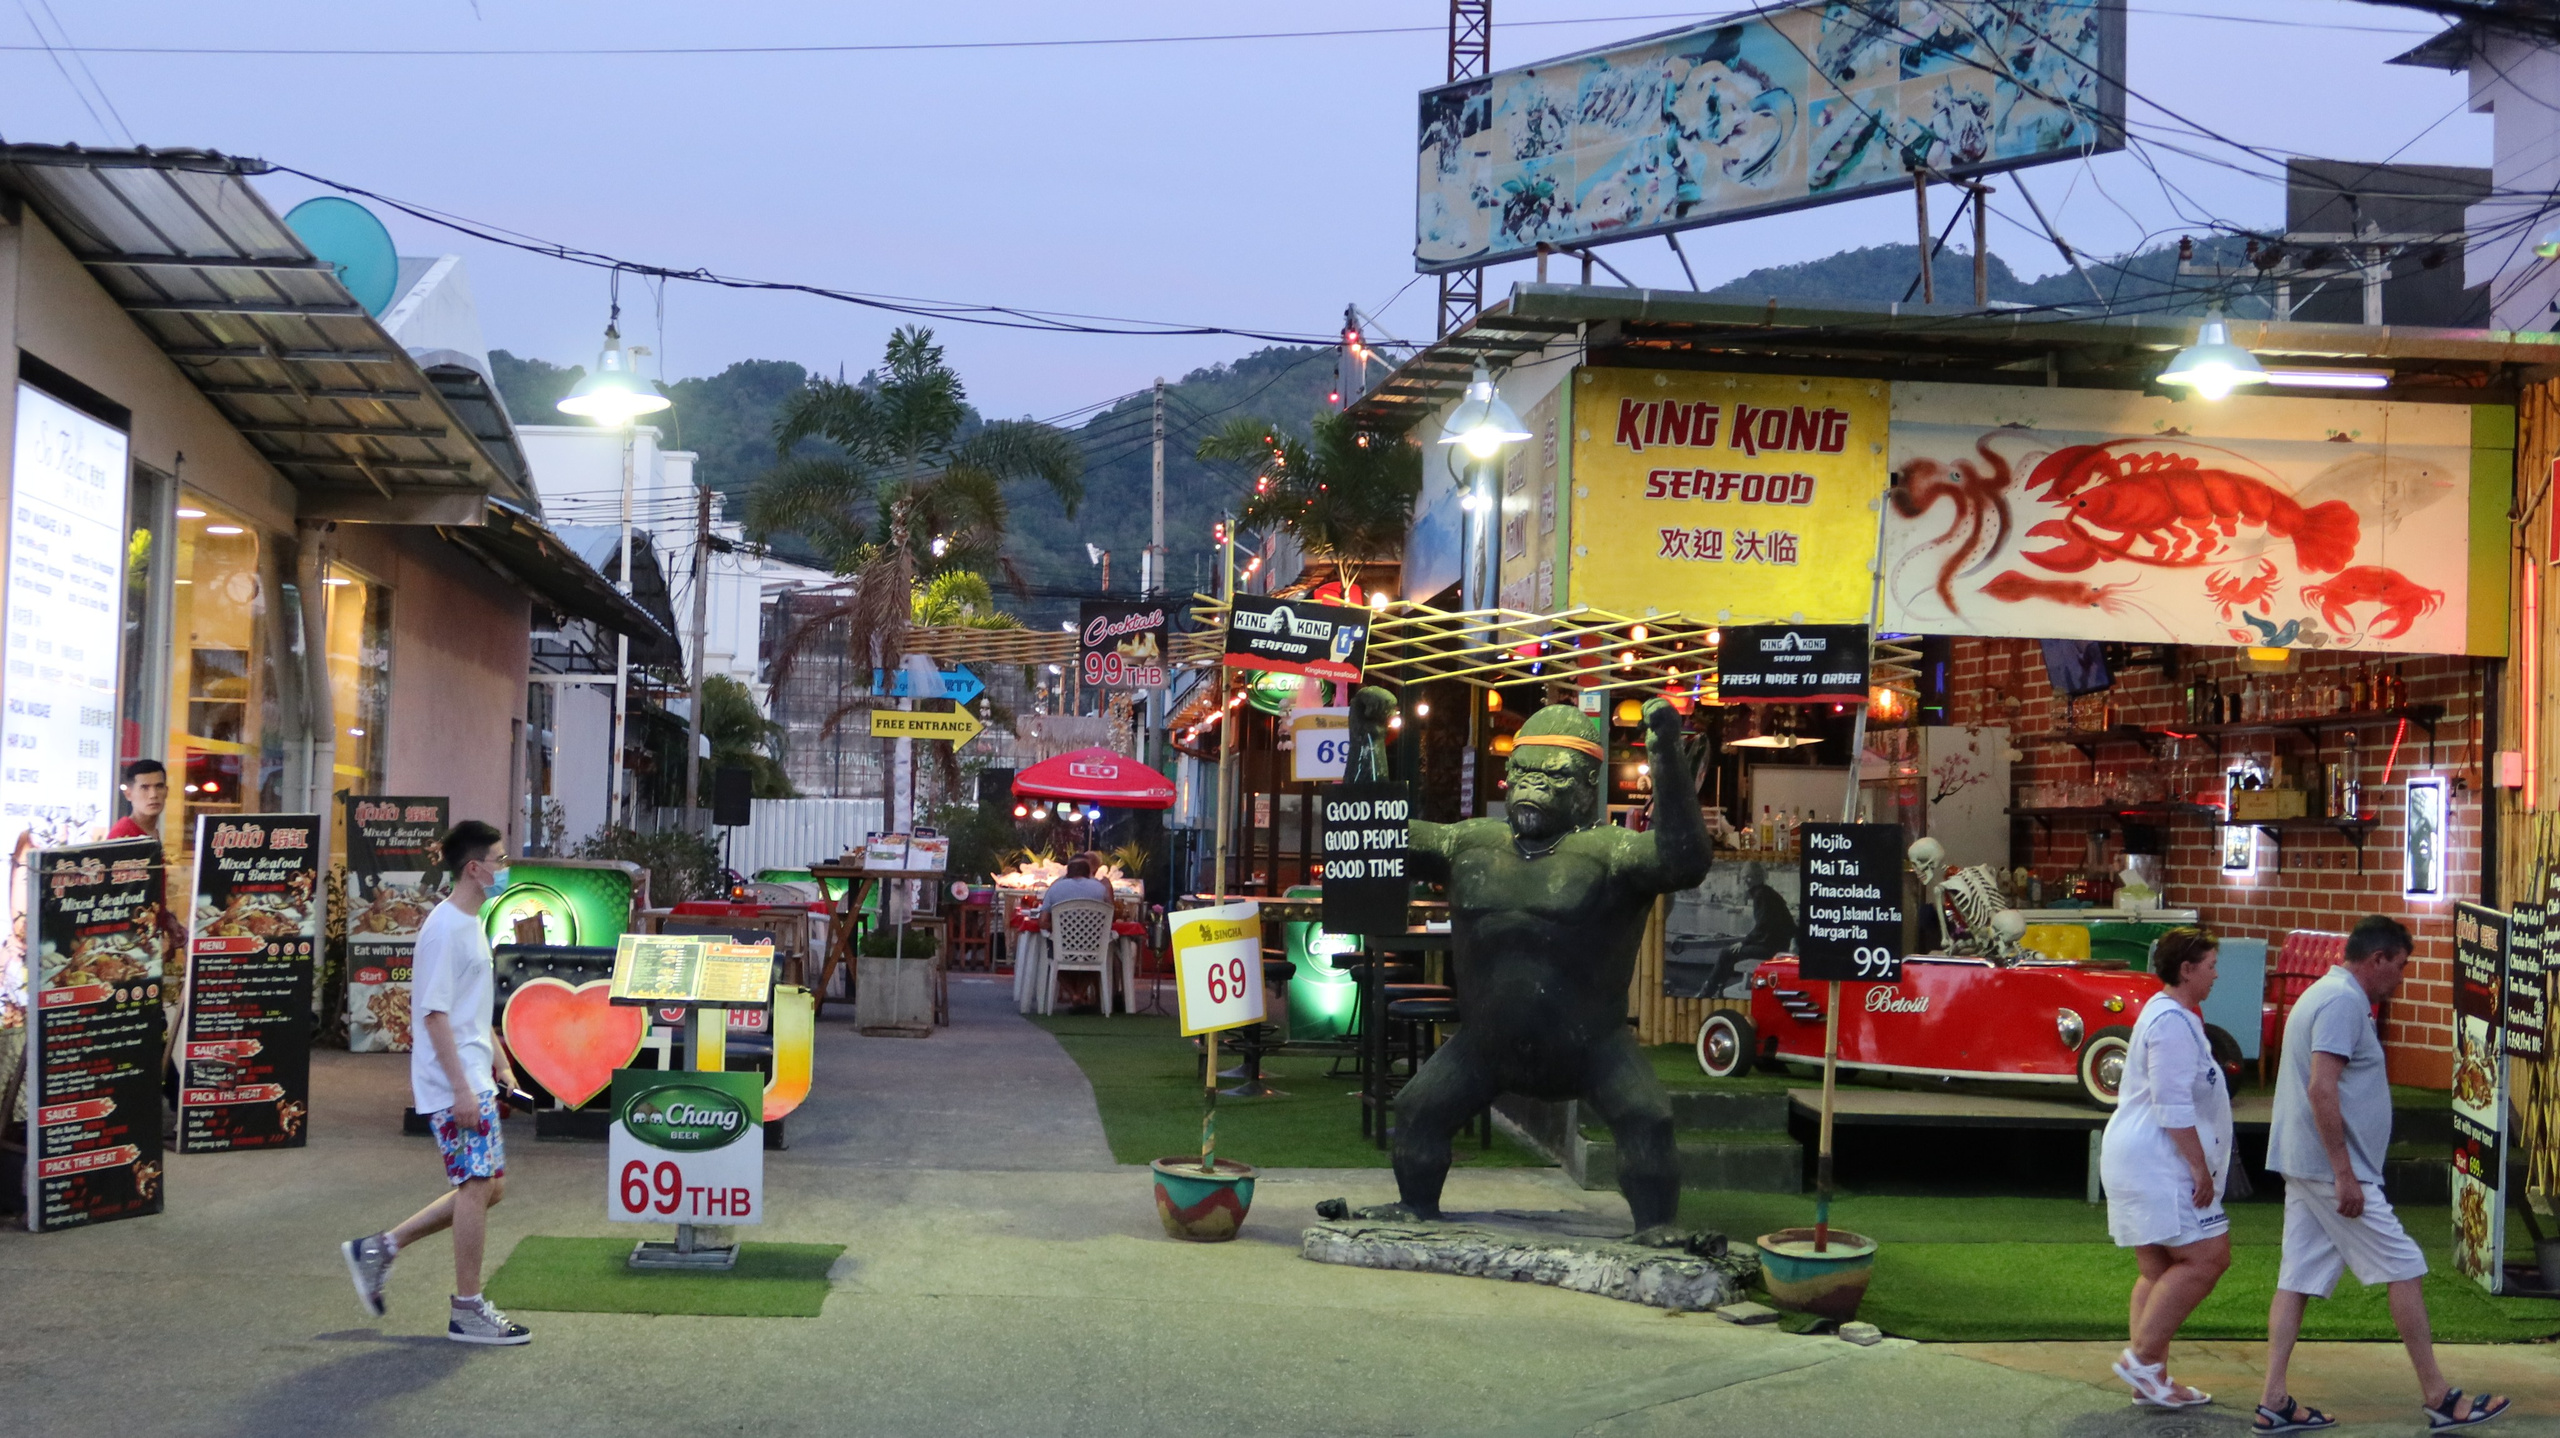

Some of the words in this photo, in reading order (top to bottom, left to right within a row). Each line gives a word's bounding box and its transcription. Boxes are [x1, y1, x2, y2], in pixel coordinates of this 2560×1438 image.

[1615, 397, 1720, 453] KING
[1730, 403, 1849, 457] KONG
[1645, 467, 1816, 506] SEAFOOD
[1659, 527, 1724, 561] 欢迎
[1083, 608, 1165, 647] Cocktail
[1235, 613, 1268, 629] KING
[1296, 621, 1330, 637] KONG
[1250, 638, 1308, 654] SEAFOOD
[1761, 640, 1783, 649] KING
[1802, 640, 1825, 649] KONG
[1773, 654, 1813, 663] SEAFOOD
[1084, 651, 1123, 686] 99
[1124, 666, 1163, 687] THB
[1304, 666, 1334, 679] Kingkong
[1333, 670, 1358, 680] seafood
[1721, 673, 1762, 686] FRESH
[1764, 673, 1799, 685] MADE
[1802, 673, 1818, 685] TO
[1821, 673, 1862, 685] ORDER
[875, 718, 906, 730] FREE
[908, 720, 973, 732] ENTRANCE
[1317, 739, 1351, 764] 69
[1072, 764, 1117, 778] LEO
[1326, 801, 1371, 822] GOOD
[1374, 799, 1409, 820] FOOD
[363, 827, 392, 838] Mixed
[394, 827, 435, 838] Seafood
[1324, 830, 1360, 851] GOOD
[1362, 828, 1409, 850] PEOPLE
[388, 837, 422, 847] Bucket
[1810, 832, 1853, 853] Mojito
[218, 857, 252, 870] Mixed
[255, 856, 303, 870] Seafood
[1324, 859, 1365, 879] GOOD
[1368, 858, 1405, 878] TIME
[1810, 858, 1835, 876] Mai
[1837, 859, 1860, 876] Tai
[232, 870, 245, 882] in
[247, 868, 287, 882] Bucket
[1809, 881, 1881, 900] Pinacolada
[60, 894, 96, 912] Mixed
[98, 888, 146, 908] Seafood
[75, 911, 89, 924] in
[91, 907, 130, 922] Bucket
[1809, 904, 1841, 924] Long
[1842, 905, 1874, 922] Island
[1875, 906, 1889, 922] Ice
[1889, 907, 1902, 922] Tea
[1213, 928, 1243, 941] SINGHA
[1808, 924, 1869, 942] Margarita
[198, 940, 227, 951] MENU
[353, 945, 371, 956] Eat
[372, 945, 393, 956] with
[360, 971, 383, 981] Start
[1207, 957, 1246, 1004] 69
[190, 1091, 216, 1102] PACK
[218, 1091, 236, 1101] THE
[238, 1088, 262, 1099] HEAT
[45, 1107, 78, 1122] SAUCE
[665, 1102, 739, 1131] Chang
[670, 1131, 700, 1140] BEER
[45, 1160, 72, 1173] PACK
[73, 1157, 91, 1169] THE
[93, 1151, 117, 1165] HEAT
[620, 1159, 683, 1215] 69
[686, 1186, 752, 1217] THB
